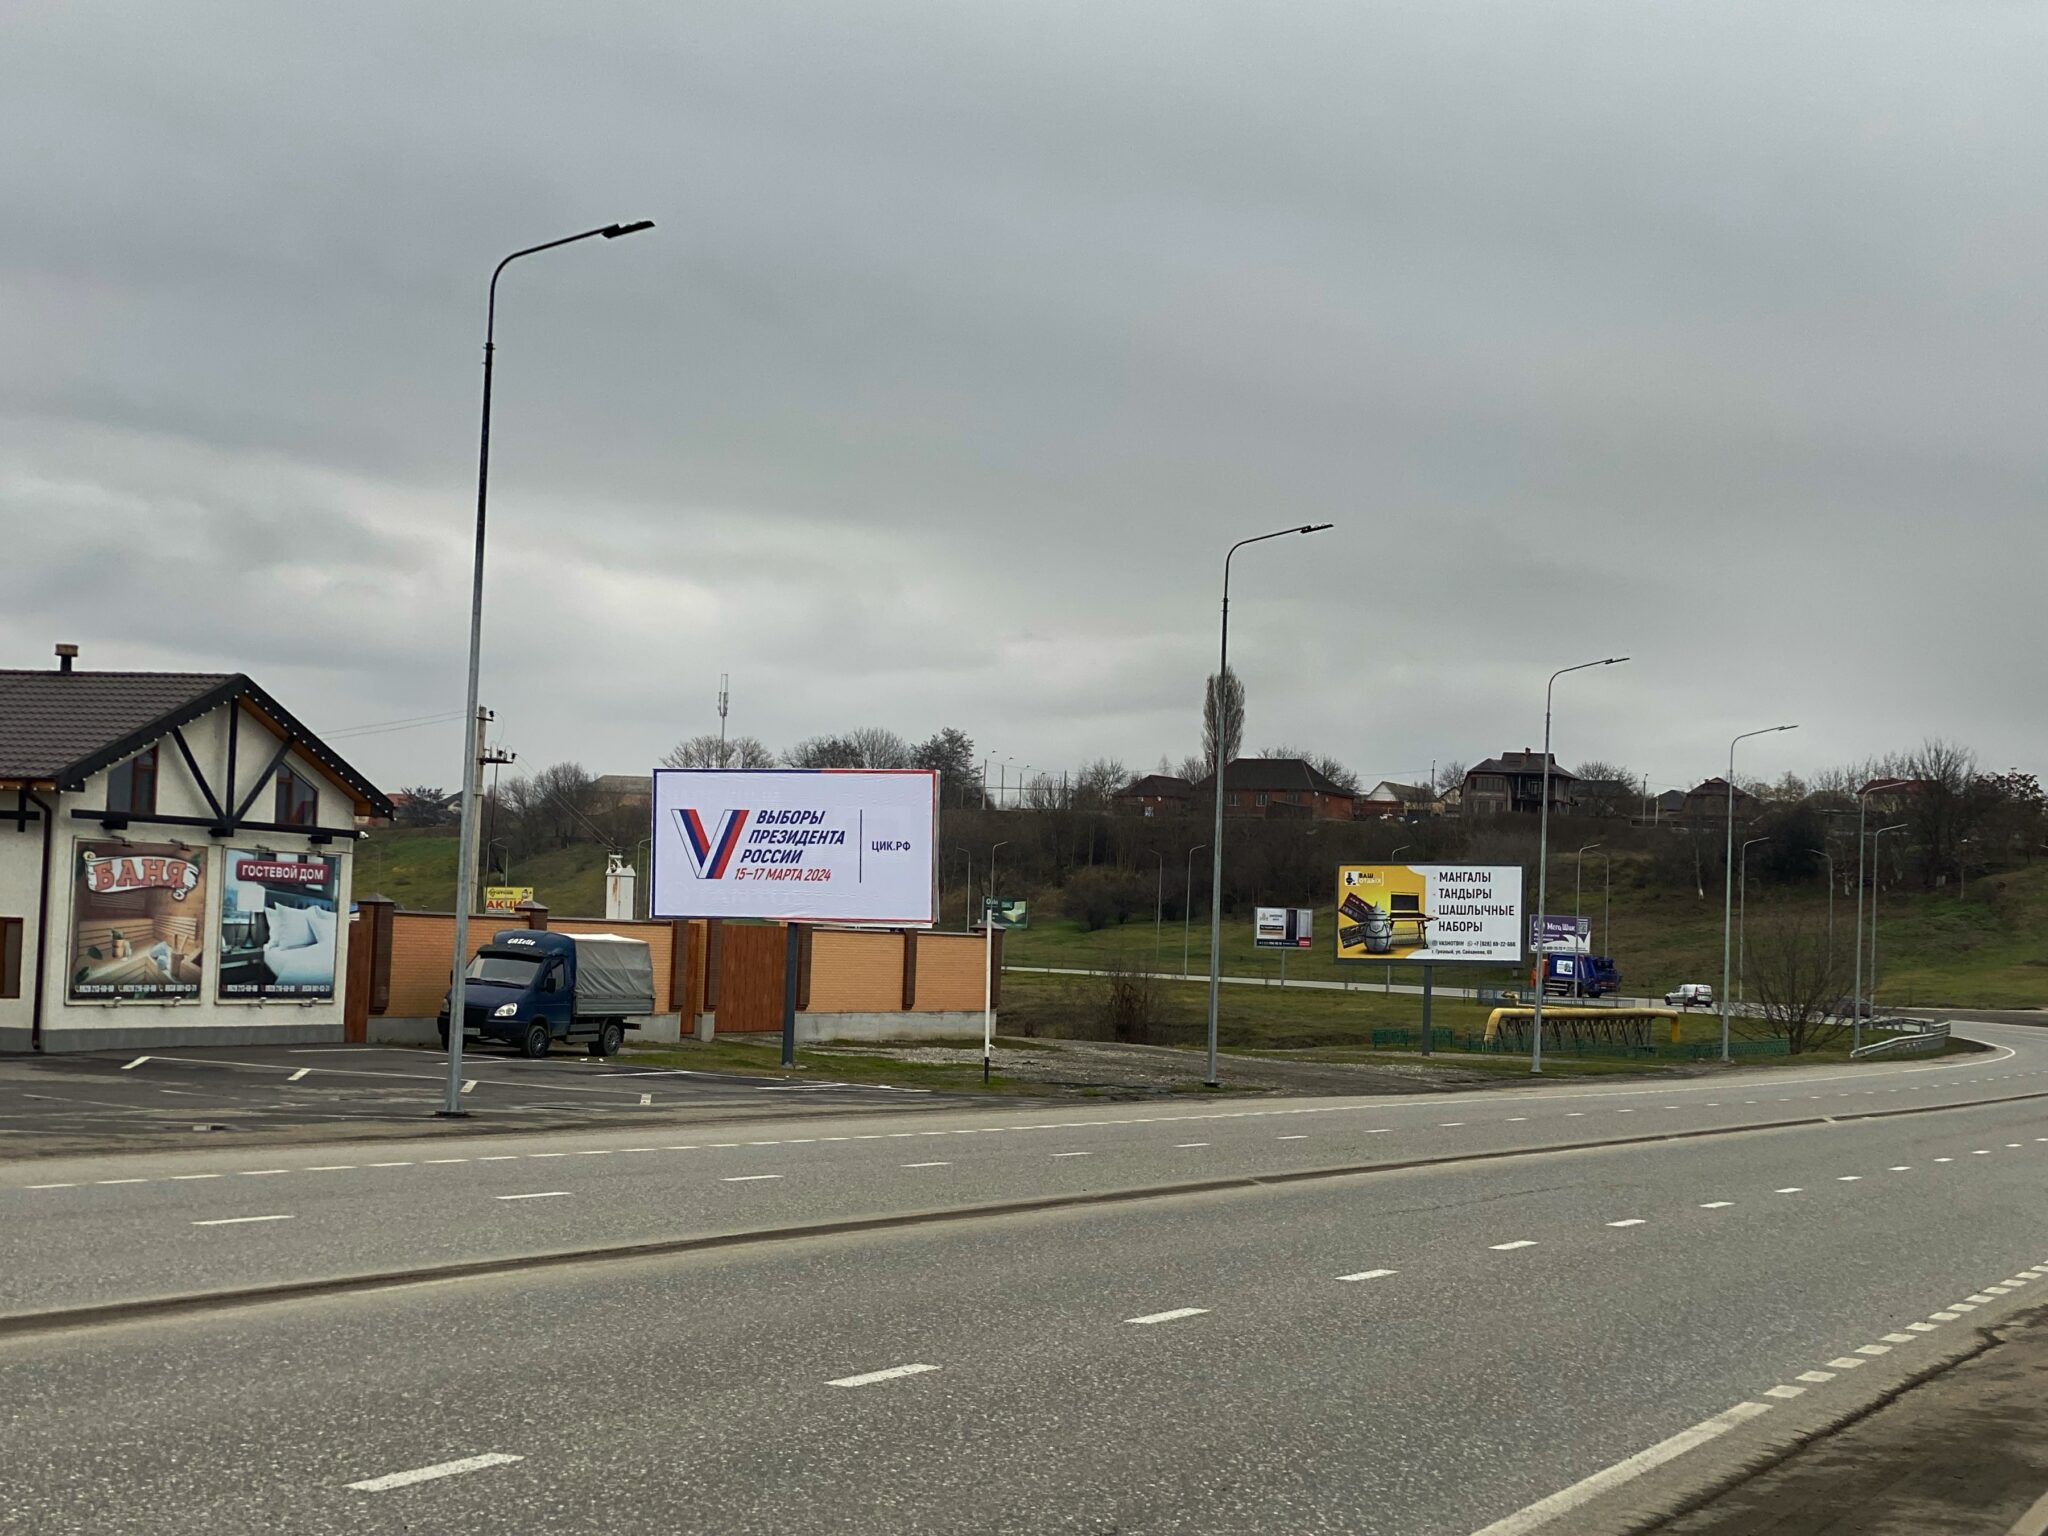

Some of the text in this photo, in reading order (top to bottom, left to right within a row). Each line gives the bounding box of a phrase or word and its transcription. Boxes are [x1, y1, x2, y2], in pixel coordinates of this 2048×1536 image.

[756, 809, 826, 825] ВЫБОРЫ
[748, 829, 846, 847] ПРЕЗИДЕНТА
[871, 840, 911, 853] ЦИК.РФ
[740, 849, 803, 864] РОССИИ
[94, 858, 187, 891] БАНЯ
[242, 863, 324, 881] ГОСТЕВОЙ ДОМ
[765, 868, 802, 881] МАРТА
[803, 869, 832, 882] 2024
[1439, 871, 1491, 883] МАНГАЛЫ
[1438, 888, 1492, 901] ТАНДЫРЫ
[1438, 904, 1515, 916] ШАШЛЫЧНЫЕ
[1438, 921, 1483, 932] НАБОРЫ
